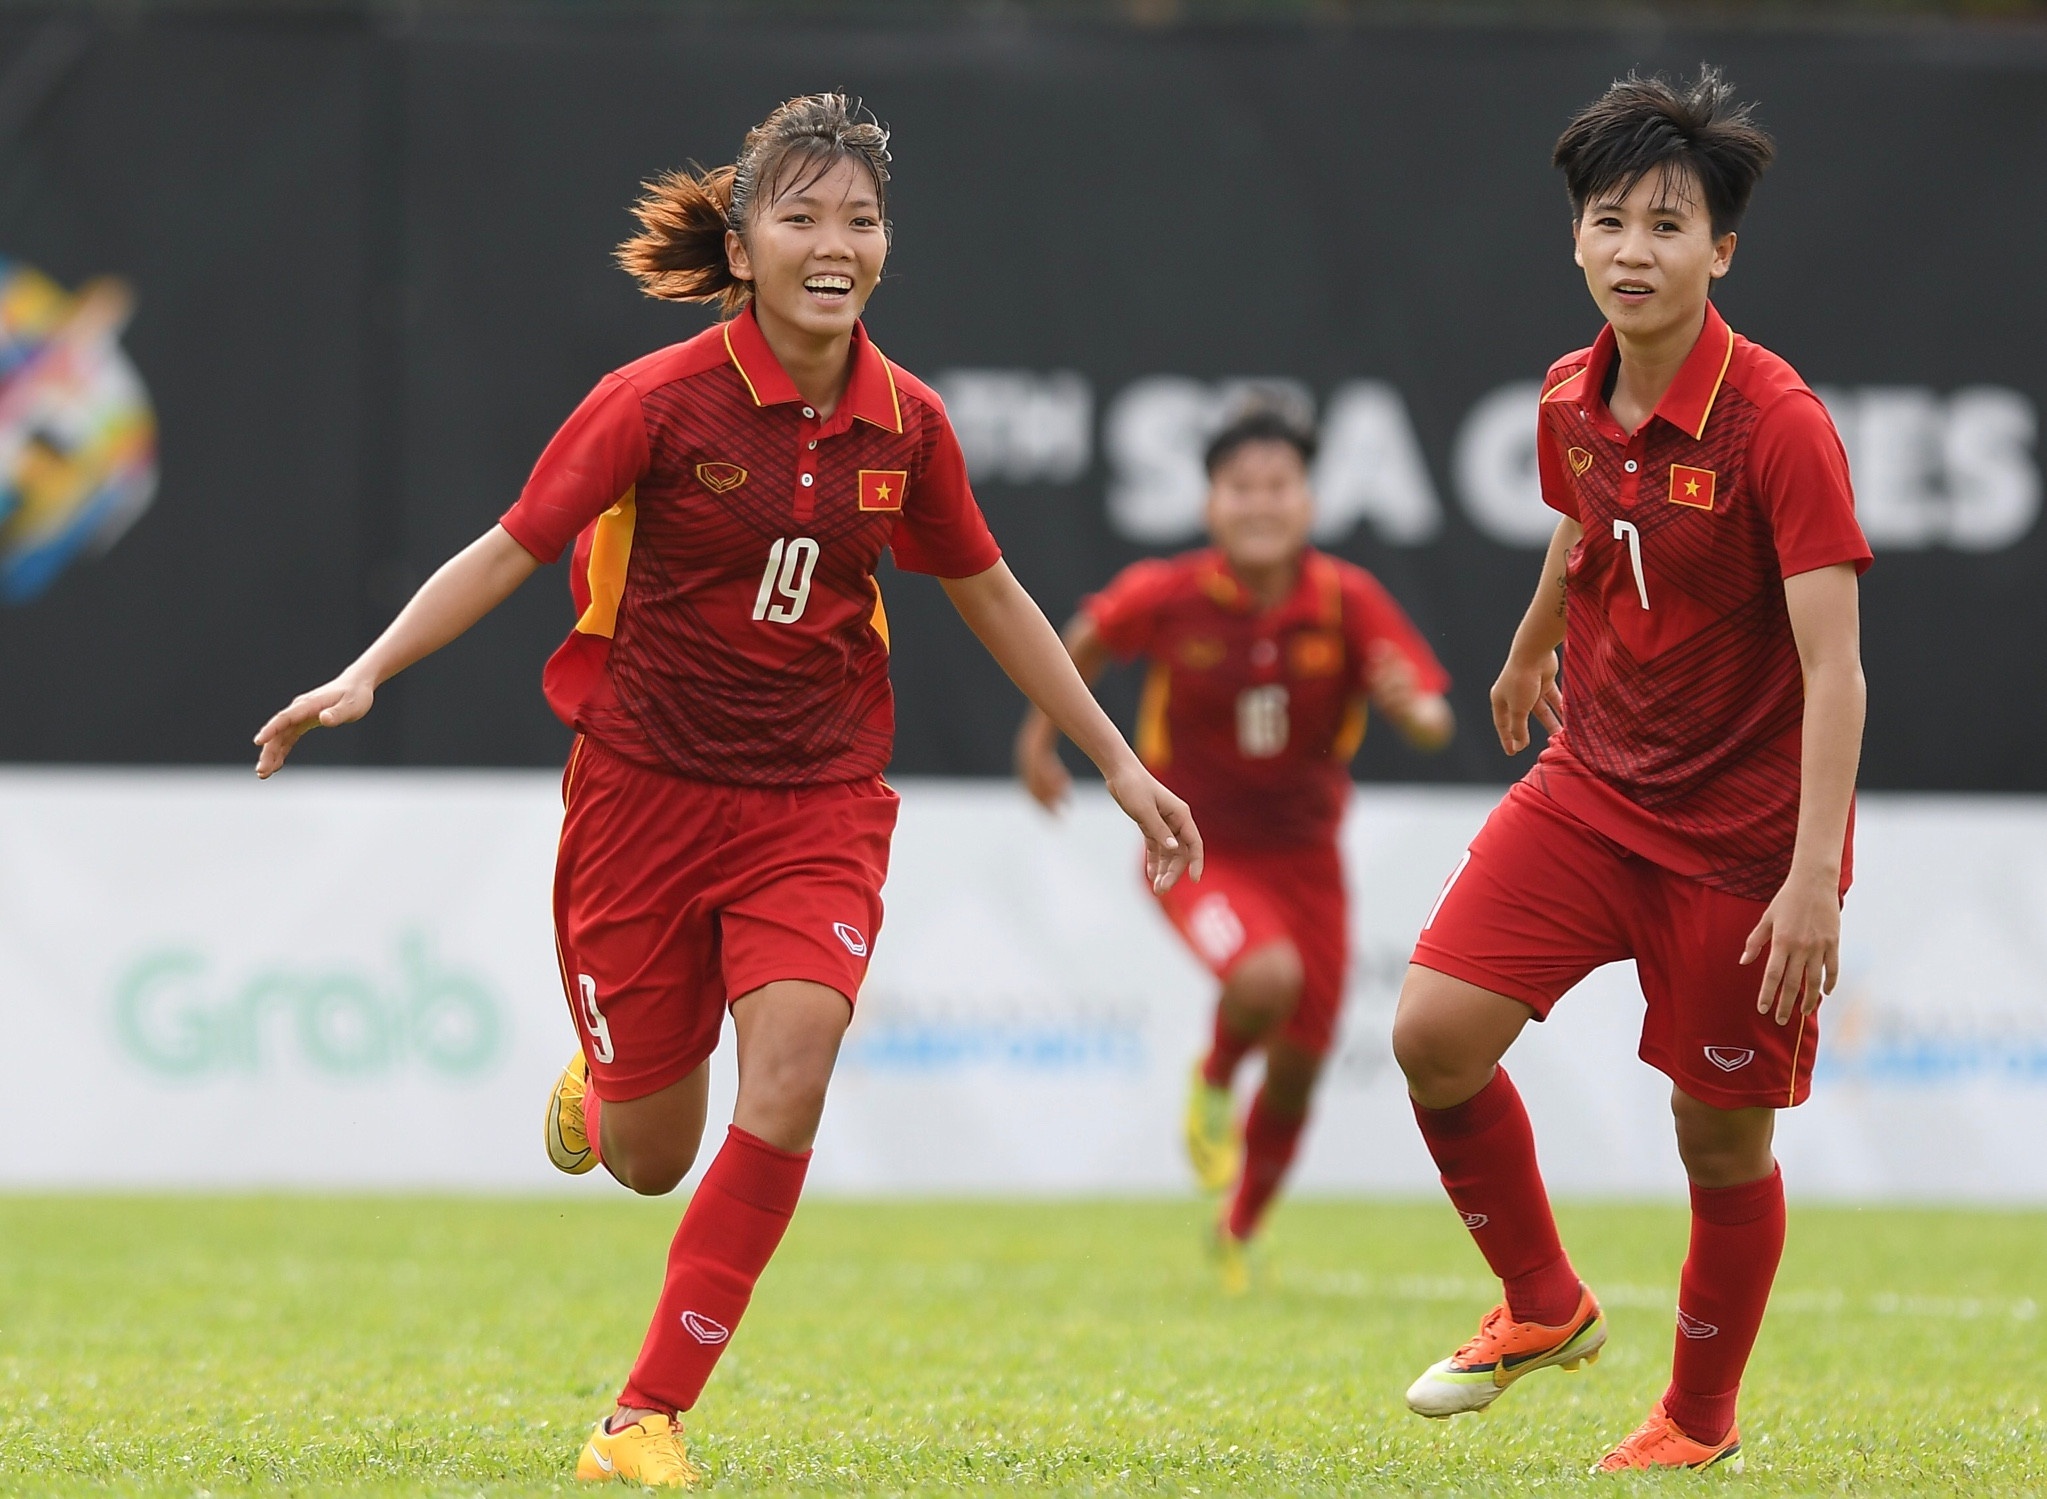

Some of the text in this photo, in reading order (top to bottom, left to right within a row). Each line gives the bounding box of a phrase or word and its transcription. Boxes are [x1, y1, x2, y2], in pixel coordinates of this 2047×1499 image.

[1454, 380, 2043, 552] GES
[752, 537, 820, 624] 19
[1613, 519, 1650, 610] 7
[113, 932, 504, 1079] Grab
